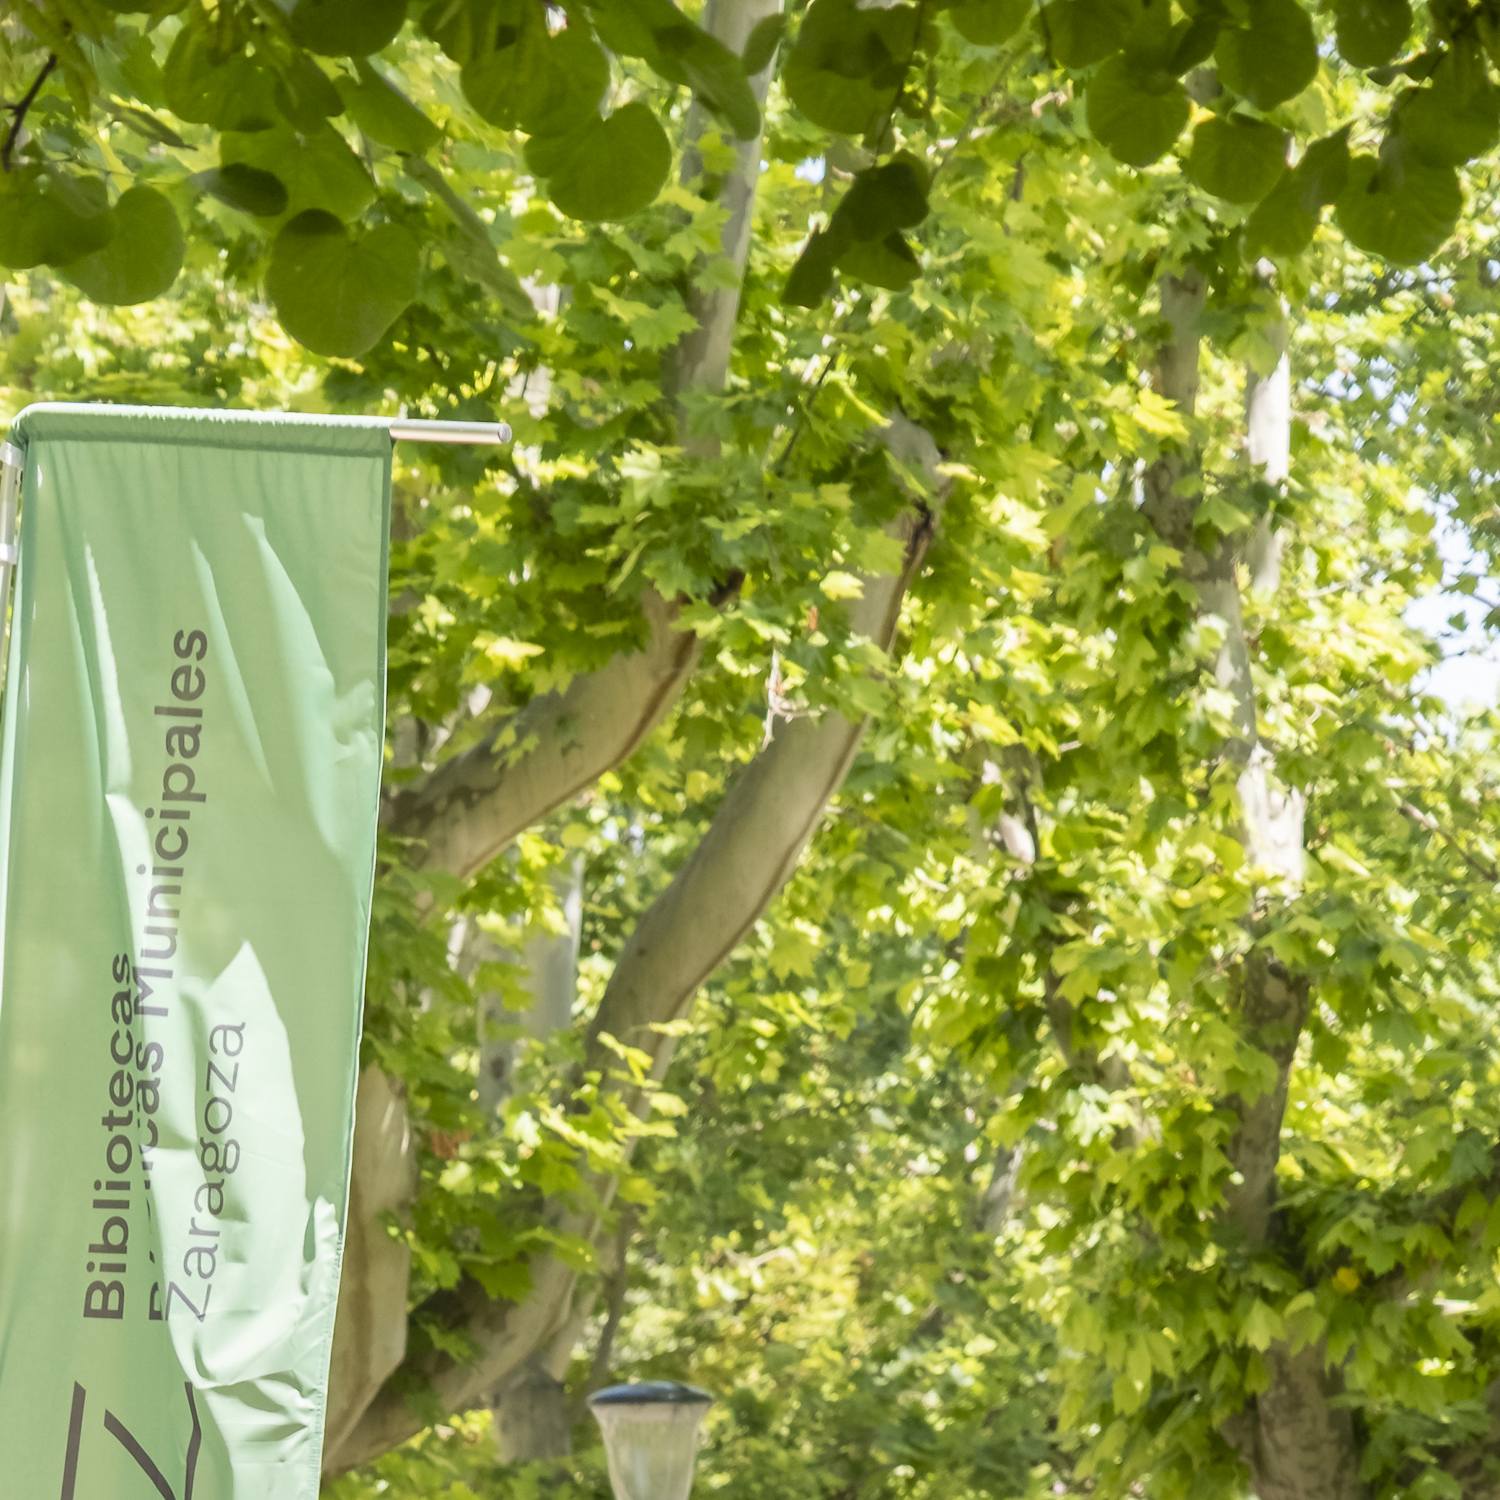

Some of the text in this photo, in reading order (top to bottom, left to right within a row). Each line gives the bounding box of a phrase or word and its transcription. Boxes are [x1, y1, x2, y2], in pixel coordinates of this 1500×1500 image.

[132, 629, 208, 1018] Municipales
[83, 953, 135, 1321] Bibliotecas
[166, 1021, 247, 1323] Zaragoza
